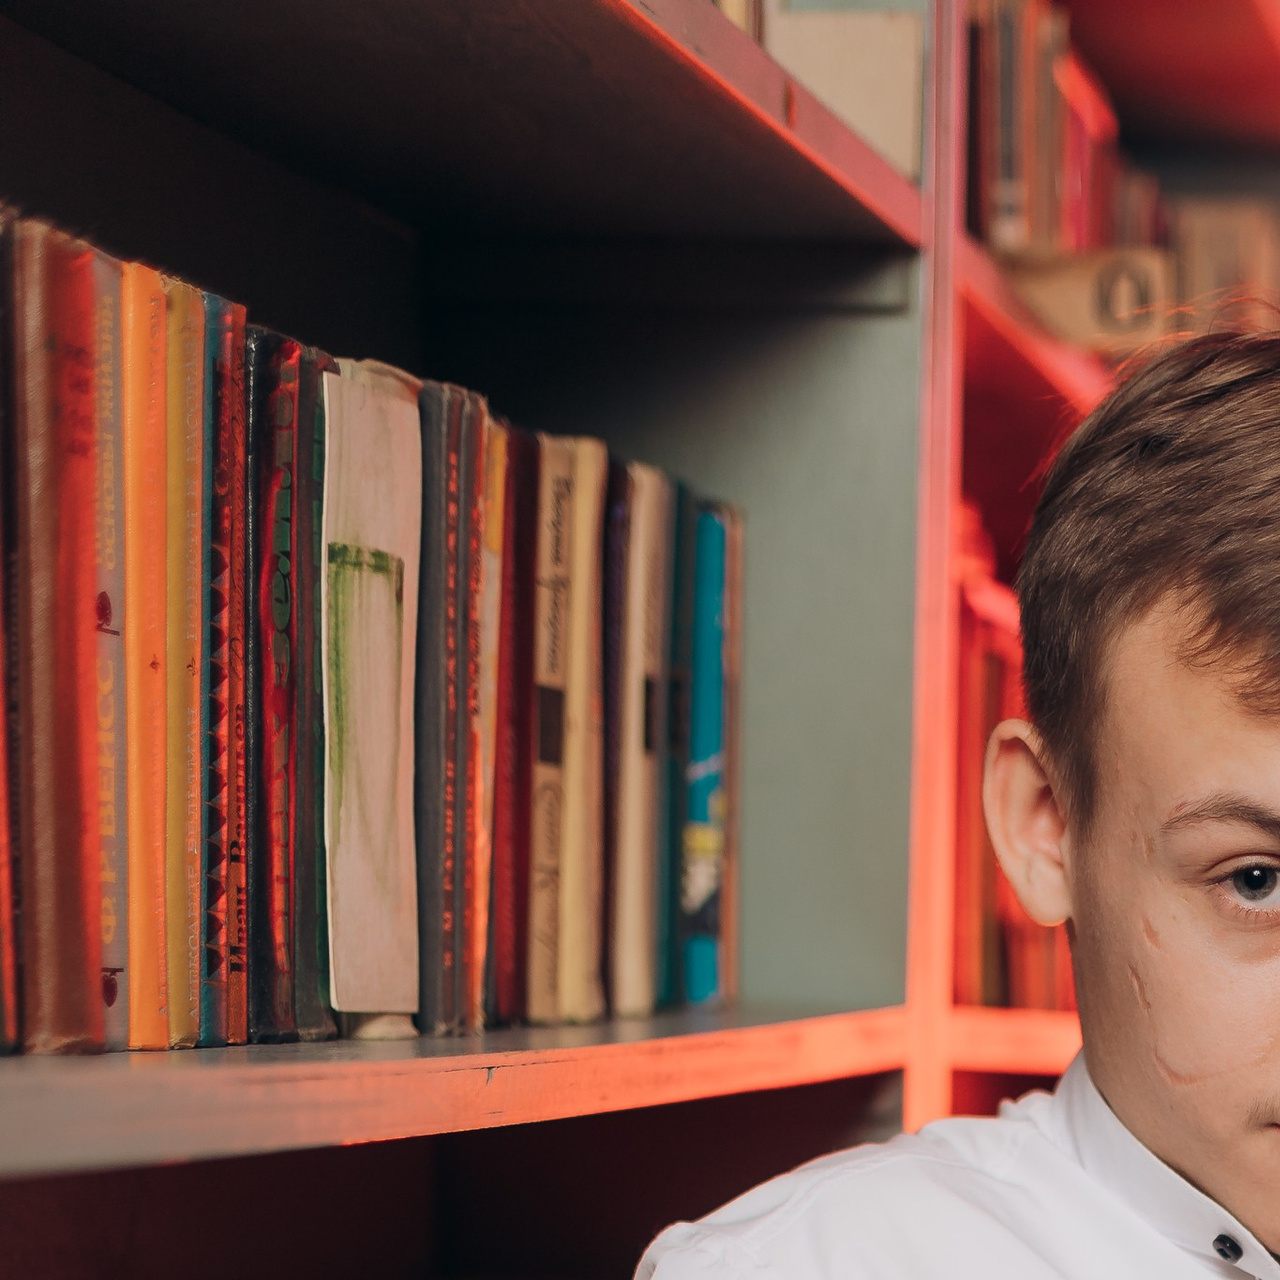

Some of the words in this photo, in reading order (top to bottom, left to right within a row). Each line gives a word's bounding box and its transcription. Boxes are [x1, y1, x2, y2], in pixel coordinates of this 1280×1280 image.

[99, 294, 115, 423] ЖИЗНИ
[102, 431, 118, 571] ОСНОВЫ
[185, 477, 199, 497] И
[185, 510, 199, 641] ПОВЕСТИ
[185, 707, 199, 855] ВЕЛЬТМАН
[228, 703, 247, 865] Васильев
[186, 865, 200, 1021] АЛЕКСАНДР
[229, 884, 247, 975] Иван
